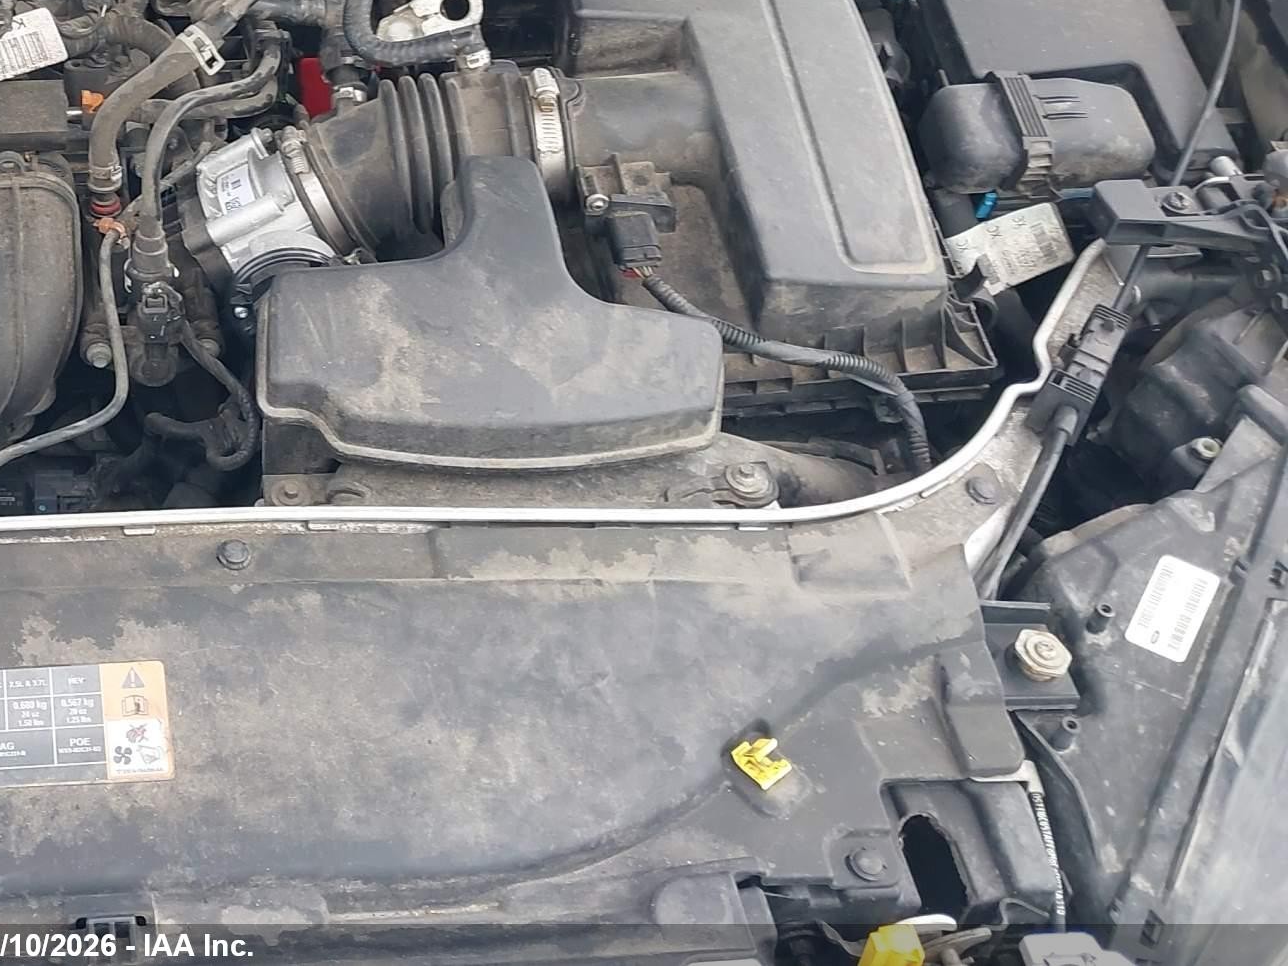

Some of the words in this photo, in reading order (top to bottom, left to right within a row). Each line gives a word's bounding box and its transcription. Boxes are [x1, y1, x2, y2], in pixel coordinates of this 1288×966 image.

[35, 699, 48, 710] kg
[82, 697, 95, 708] kg
[69, 737, 91, 746] POE
